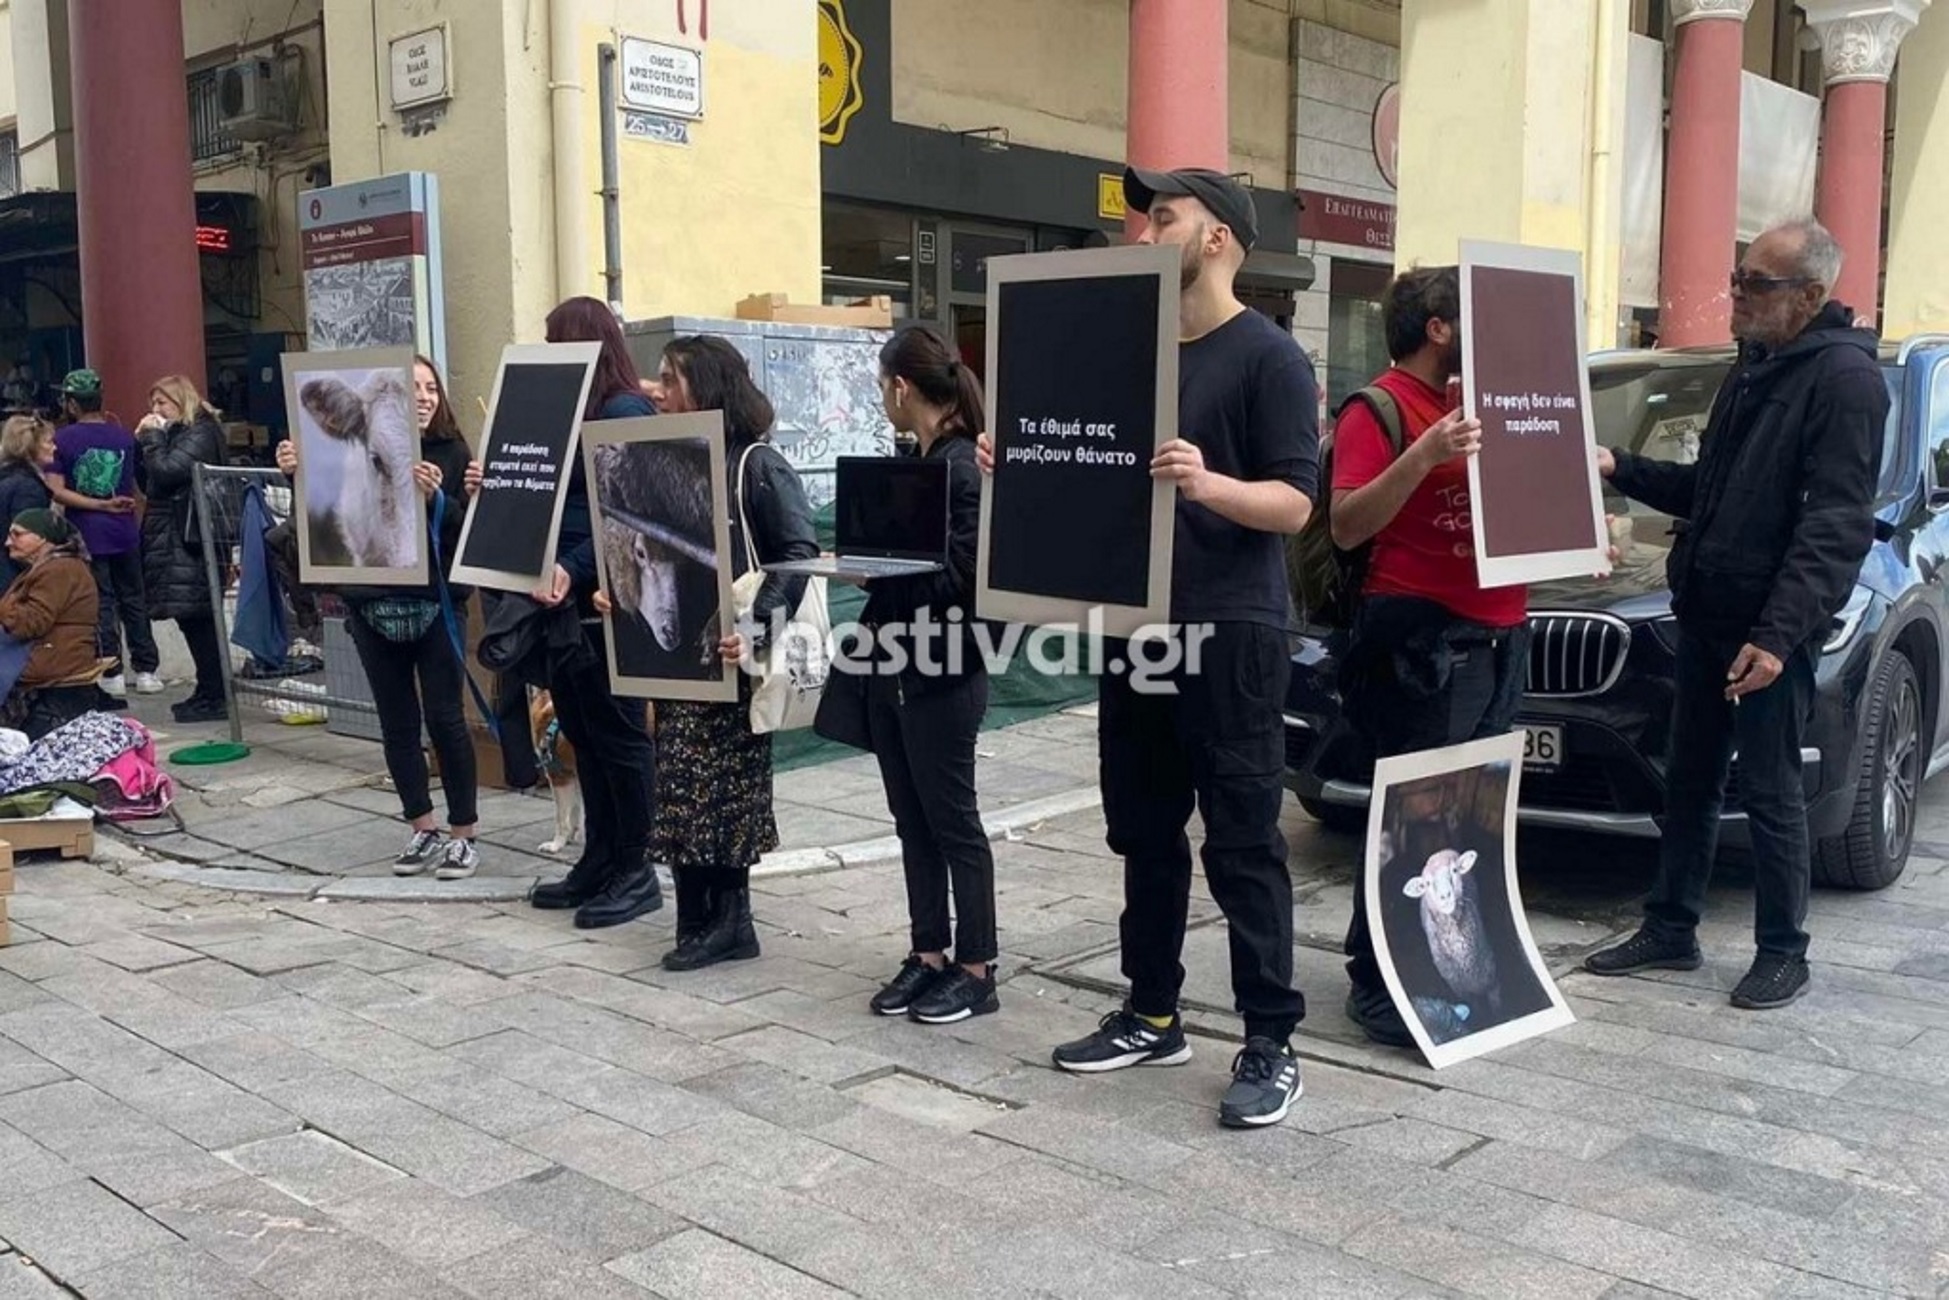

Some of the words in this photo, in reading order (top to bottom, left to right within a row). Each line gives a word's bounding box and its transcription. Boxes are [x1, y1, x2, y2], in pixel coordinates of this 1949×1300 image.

[650, 54, 675, 69] ΟΔΟΣ
[629, 66, 696, 88] ΑΡΙΣΤΟΤΕΛΟΥΣ
[629, 81, 695, 101] ARISTOTELOUS
[1482, 392, 1493, 408] Η
[1494, 391, 1530, 411] σφαγή
[1531, 392, 1551, 408] δεν
[1553, 392, 1575, 408] είναι
[1019, 418, 1037, 434] Τα
[1040, 417, 1081, 439] έθιμά
[1085, 423, 1116, 441] σας
[1505, 415, 1560, 435] παράδοση
[1006, 443, 1071, 465] μυρίζουν
[1075, 445, 1136, 465] θάνατο
